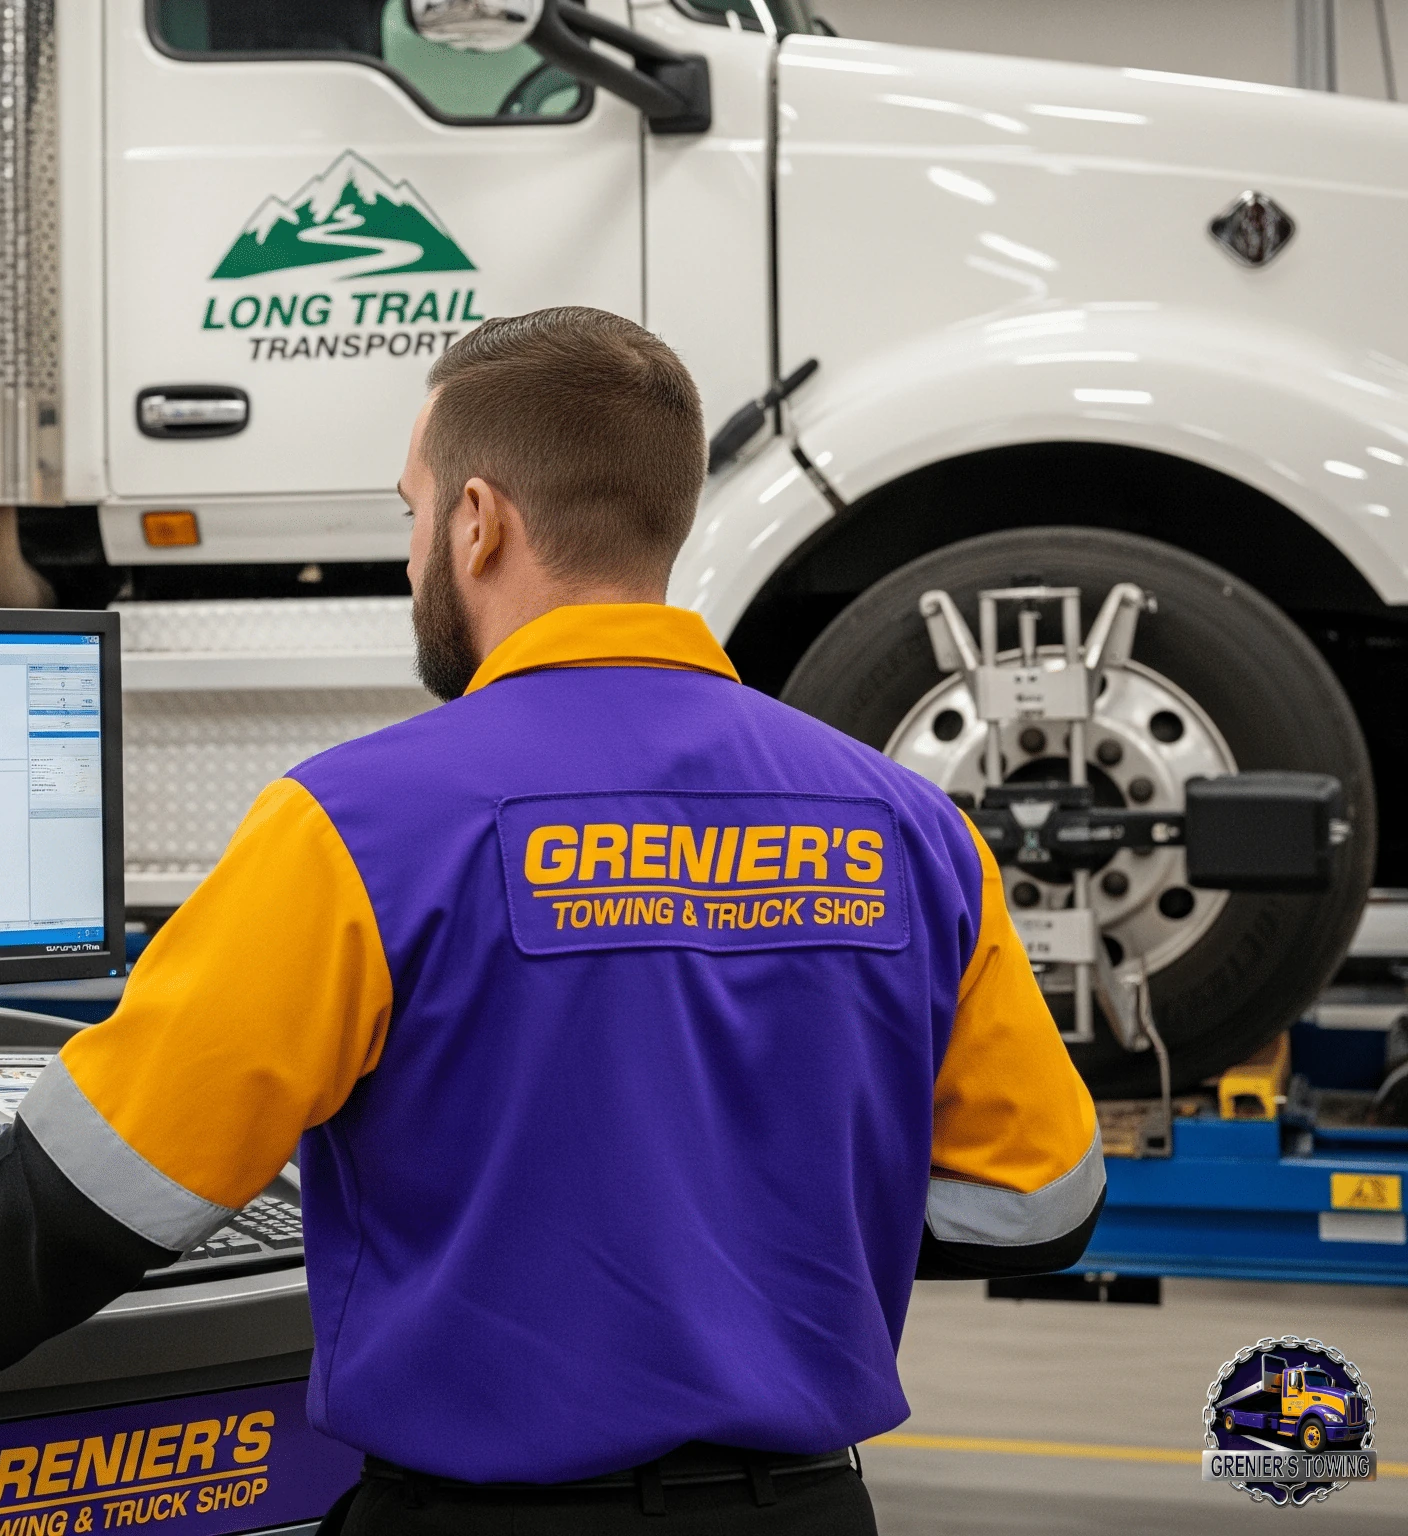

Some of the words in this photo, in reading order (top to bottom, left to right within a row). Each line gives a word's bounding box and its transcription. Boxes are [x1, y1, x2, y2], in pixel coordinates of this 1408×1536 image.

[202, 293, 333, 330] LONG
[351, 289, 485, 326] TRAIL
[249, 331, 459, 361] TRANSPORT
[524, 823, 884, 885] GRENIER'S
[552, 896, 674, 930] TOWING
[682, 899, 699, 927] &
[704, 897, 805, 930] TRUCK
[813, 898, 885, 928] SHOP
[74, 1506, 93, 1533] &
[103, 1491, 190, 1529] TRUCK
[196, 1477, 268, 1514] SHOP
